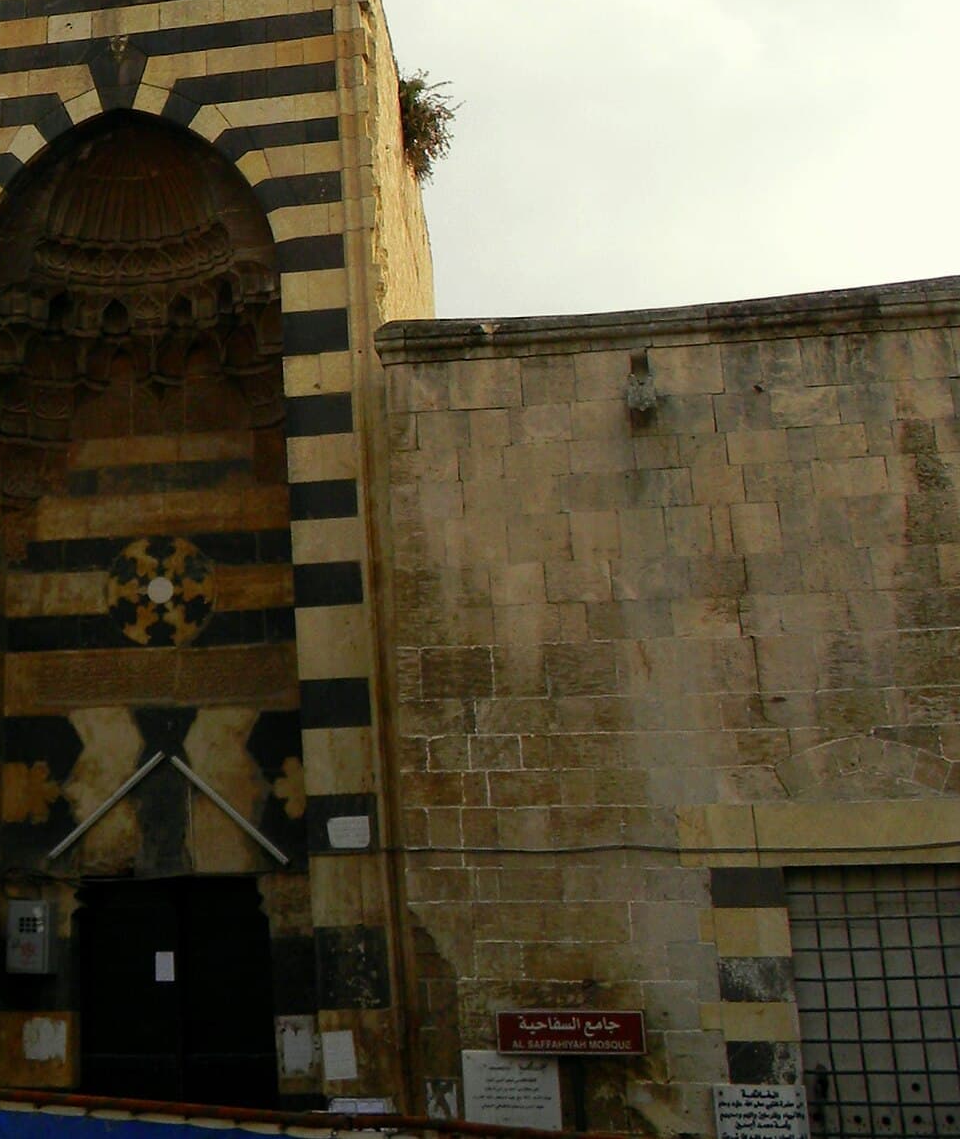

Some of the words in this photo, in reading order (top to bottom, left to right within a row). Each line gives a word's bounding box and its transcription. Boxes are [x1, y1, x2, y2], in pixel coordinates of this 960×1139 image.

[519, 1015, 581, 1035] السفاحية
[584, 1016, 620, 1036] جامع
[512, 1040, 525, 1049] AL
[527, 1040, 586, 1049] SAFFAHIYAH
[588, 1040, 632, 1049] MOSQUE
